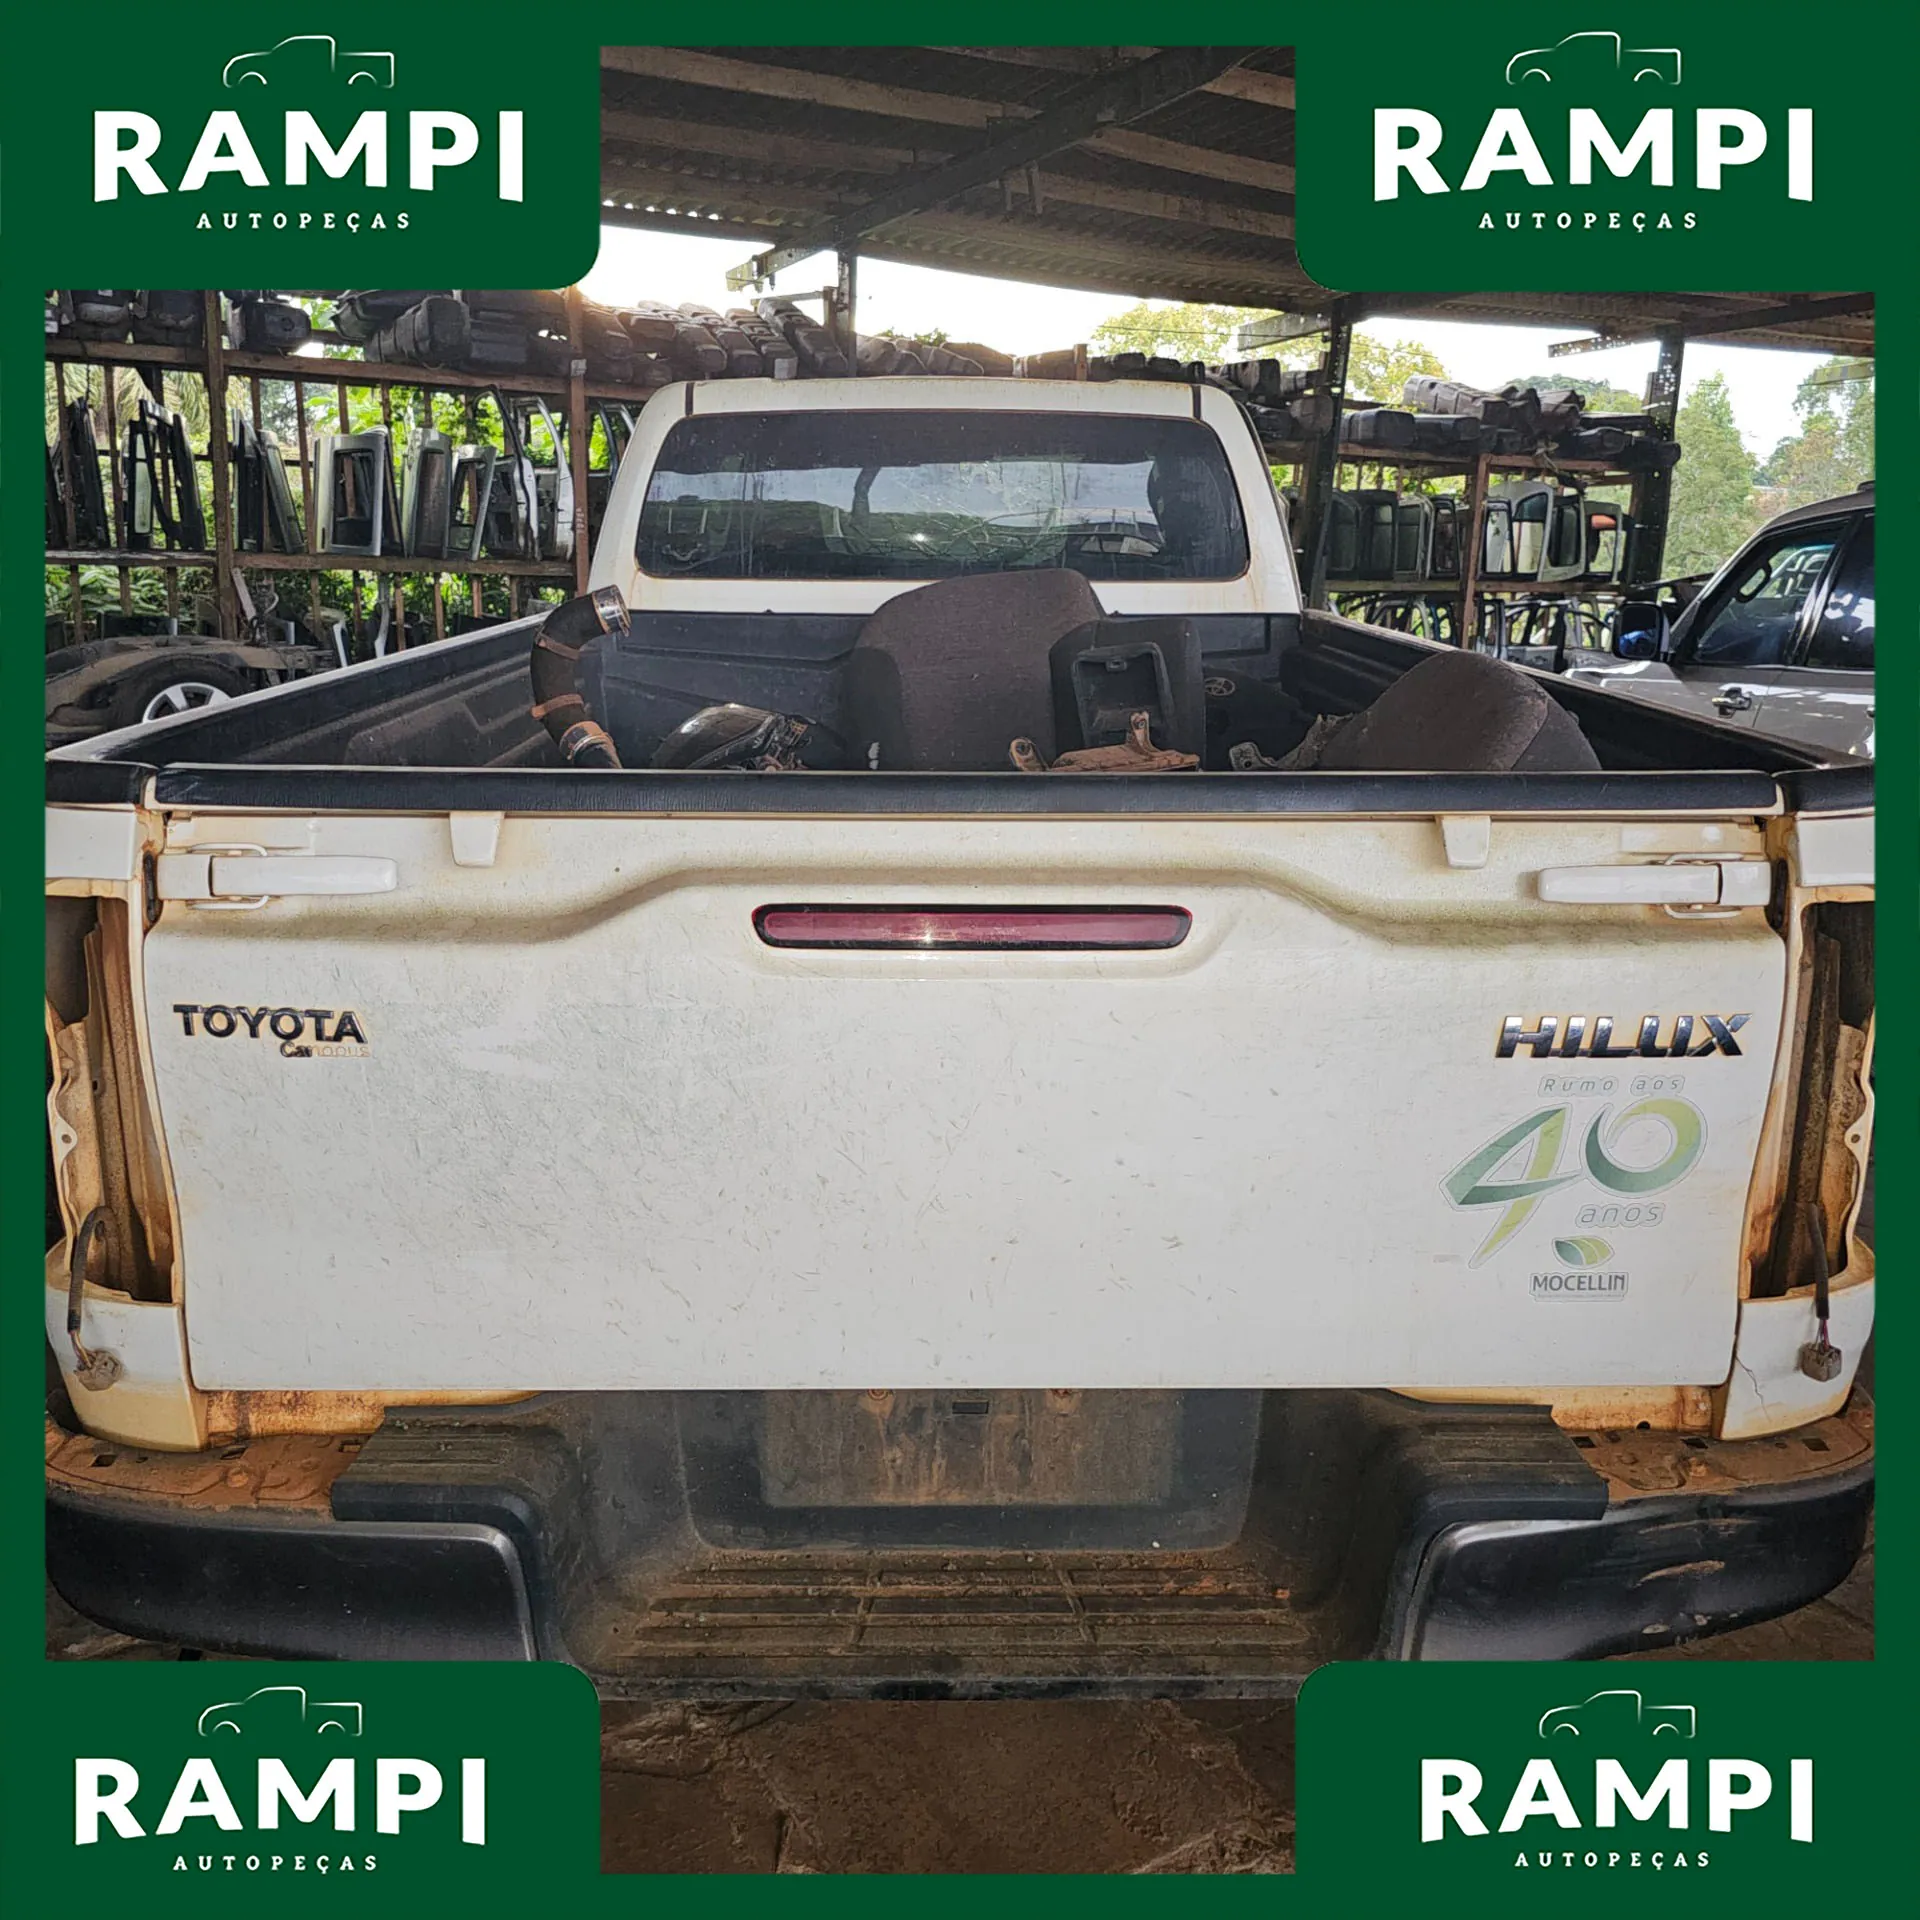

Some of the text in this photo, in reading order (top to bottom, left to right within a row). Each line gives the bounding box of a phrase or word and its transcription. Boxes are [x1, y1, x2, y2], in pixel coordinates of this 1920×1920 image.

[173, 1004, 368, 1043] TOYOTA
[1495, 1013, 1752, 1058] HILUX
[1543, 1078, 1682, 1092] Rumo aos
[1445, 1099, 1702, 1258] 40
[1580, 1206, 1662, 1223] anos
[1532, 1274, 1626, 1291] MOCELLIN
